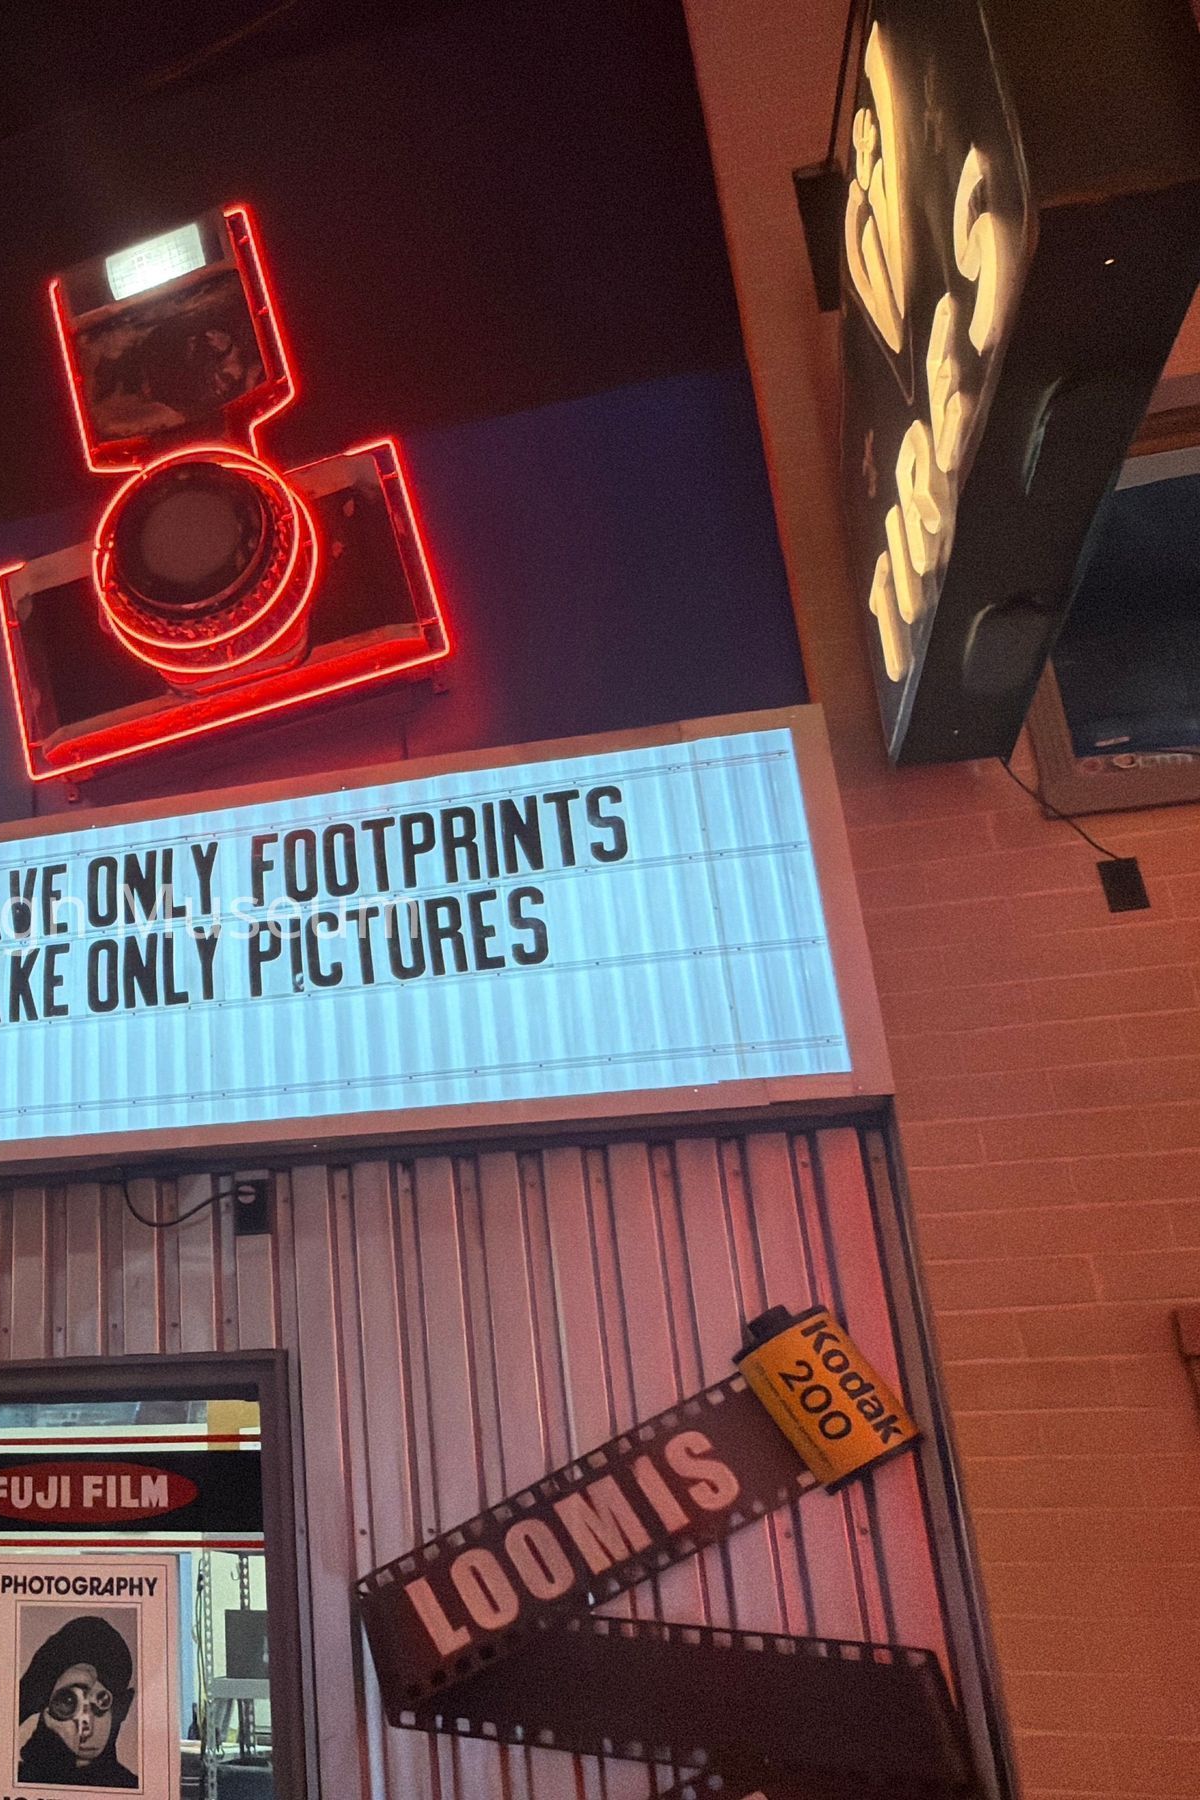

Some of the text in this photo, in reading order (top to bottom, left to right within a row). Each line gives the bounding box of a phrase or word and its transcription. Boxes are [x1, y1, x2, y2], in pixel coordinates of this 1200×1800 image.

[87, 842, 219, 928] ONLY
[250, 785, 629, 907] FOOTPRINTS
[87, 924, 221, 1013] ONLY
[248, 886, 550, 997] PICTURES
[778, 1359, 853, 1441] 200
[801, 1320, 904, 1444] Kodak
[83, 1475, 169, 1509] FILM
[404, 1429, 741, 1658] LOOMIS
[1, 1575, 158, 1598] PHOTOGRAPHY
